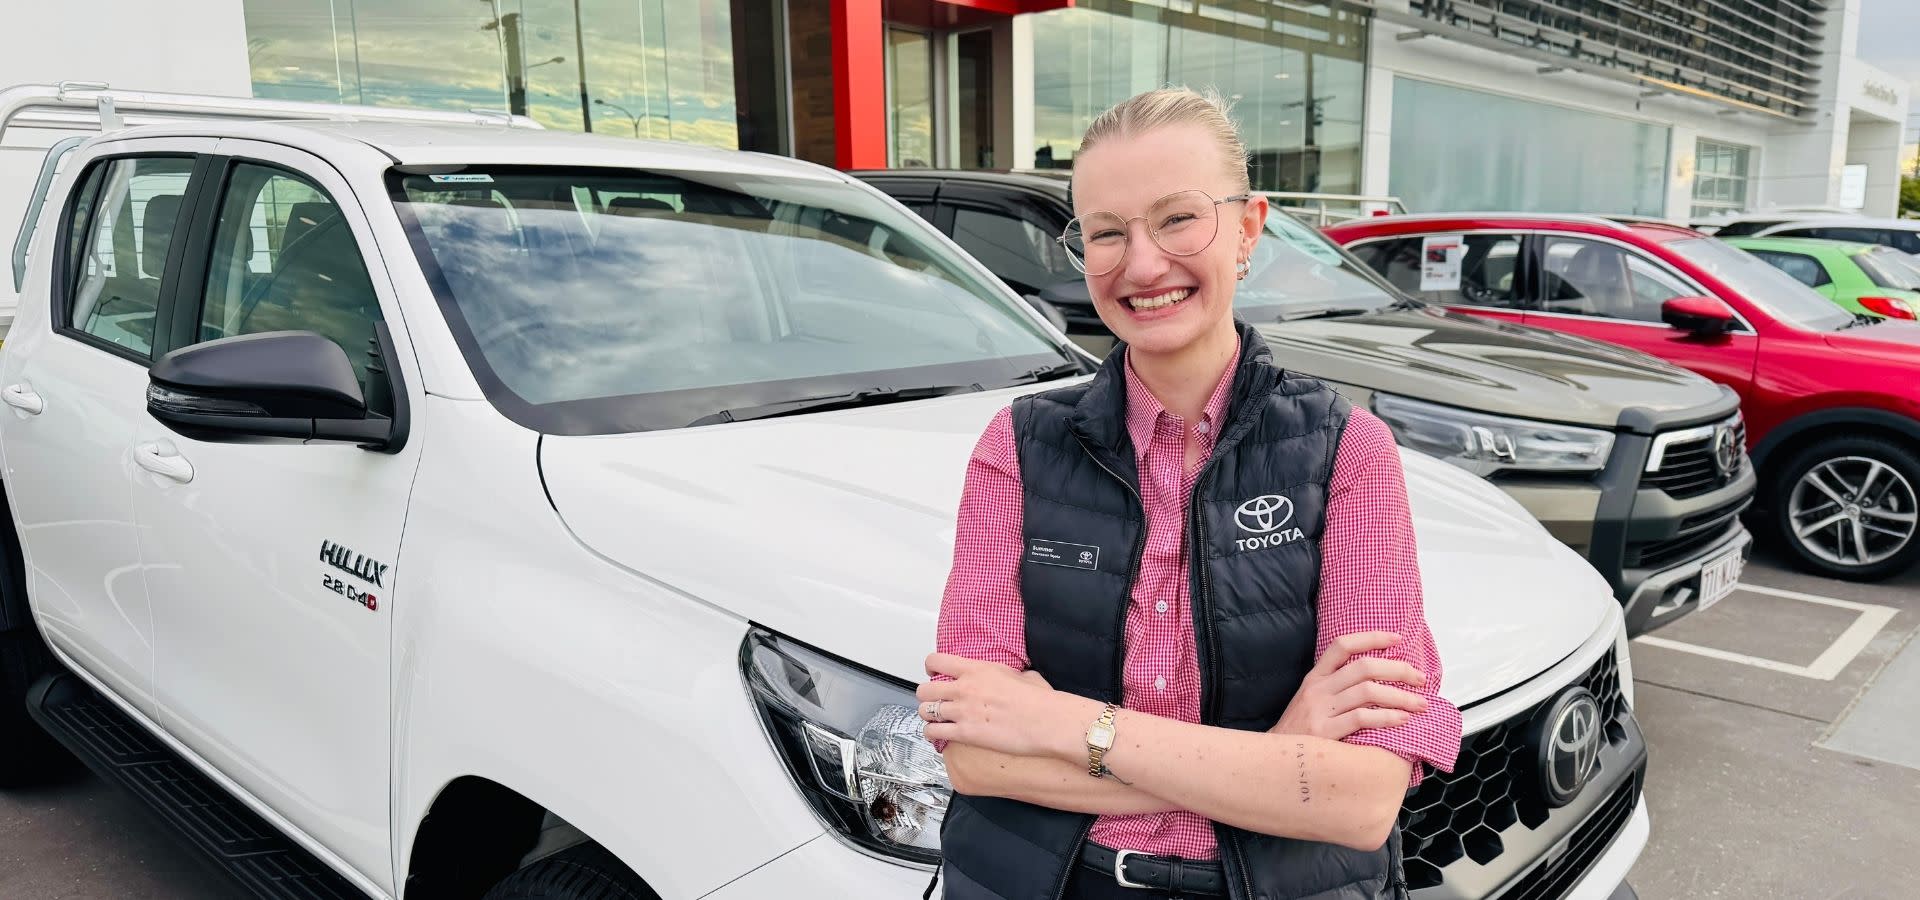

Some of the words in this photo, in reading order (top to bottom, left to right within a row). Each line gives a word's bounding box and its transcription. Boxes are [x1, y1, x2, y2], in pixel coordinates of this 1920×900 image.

[1235, 527, 1305, 551] TOYOTA
[320, 539, 388, 588] HILUX
[347, 584, 379, 612] D-4D
[1296, 743, 1311, 803] PASSION
